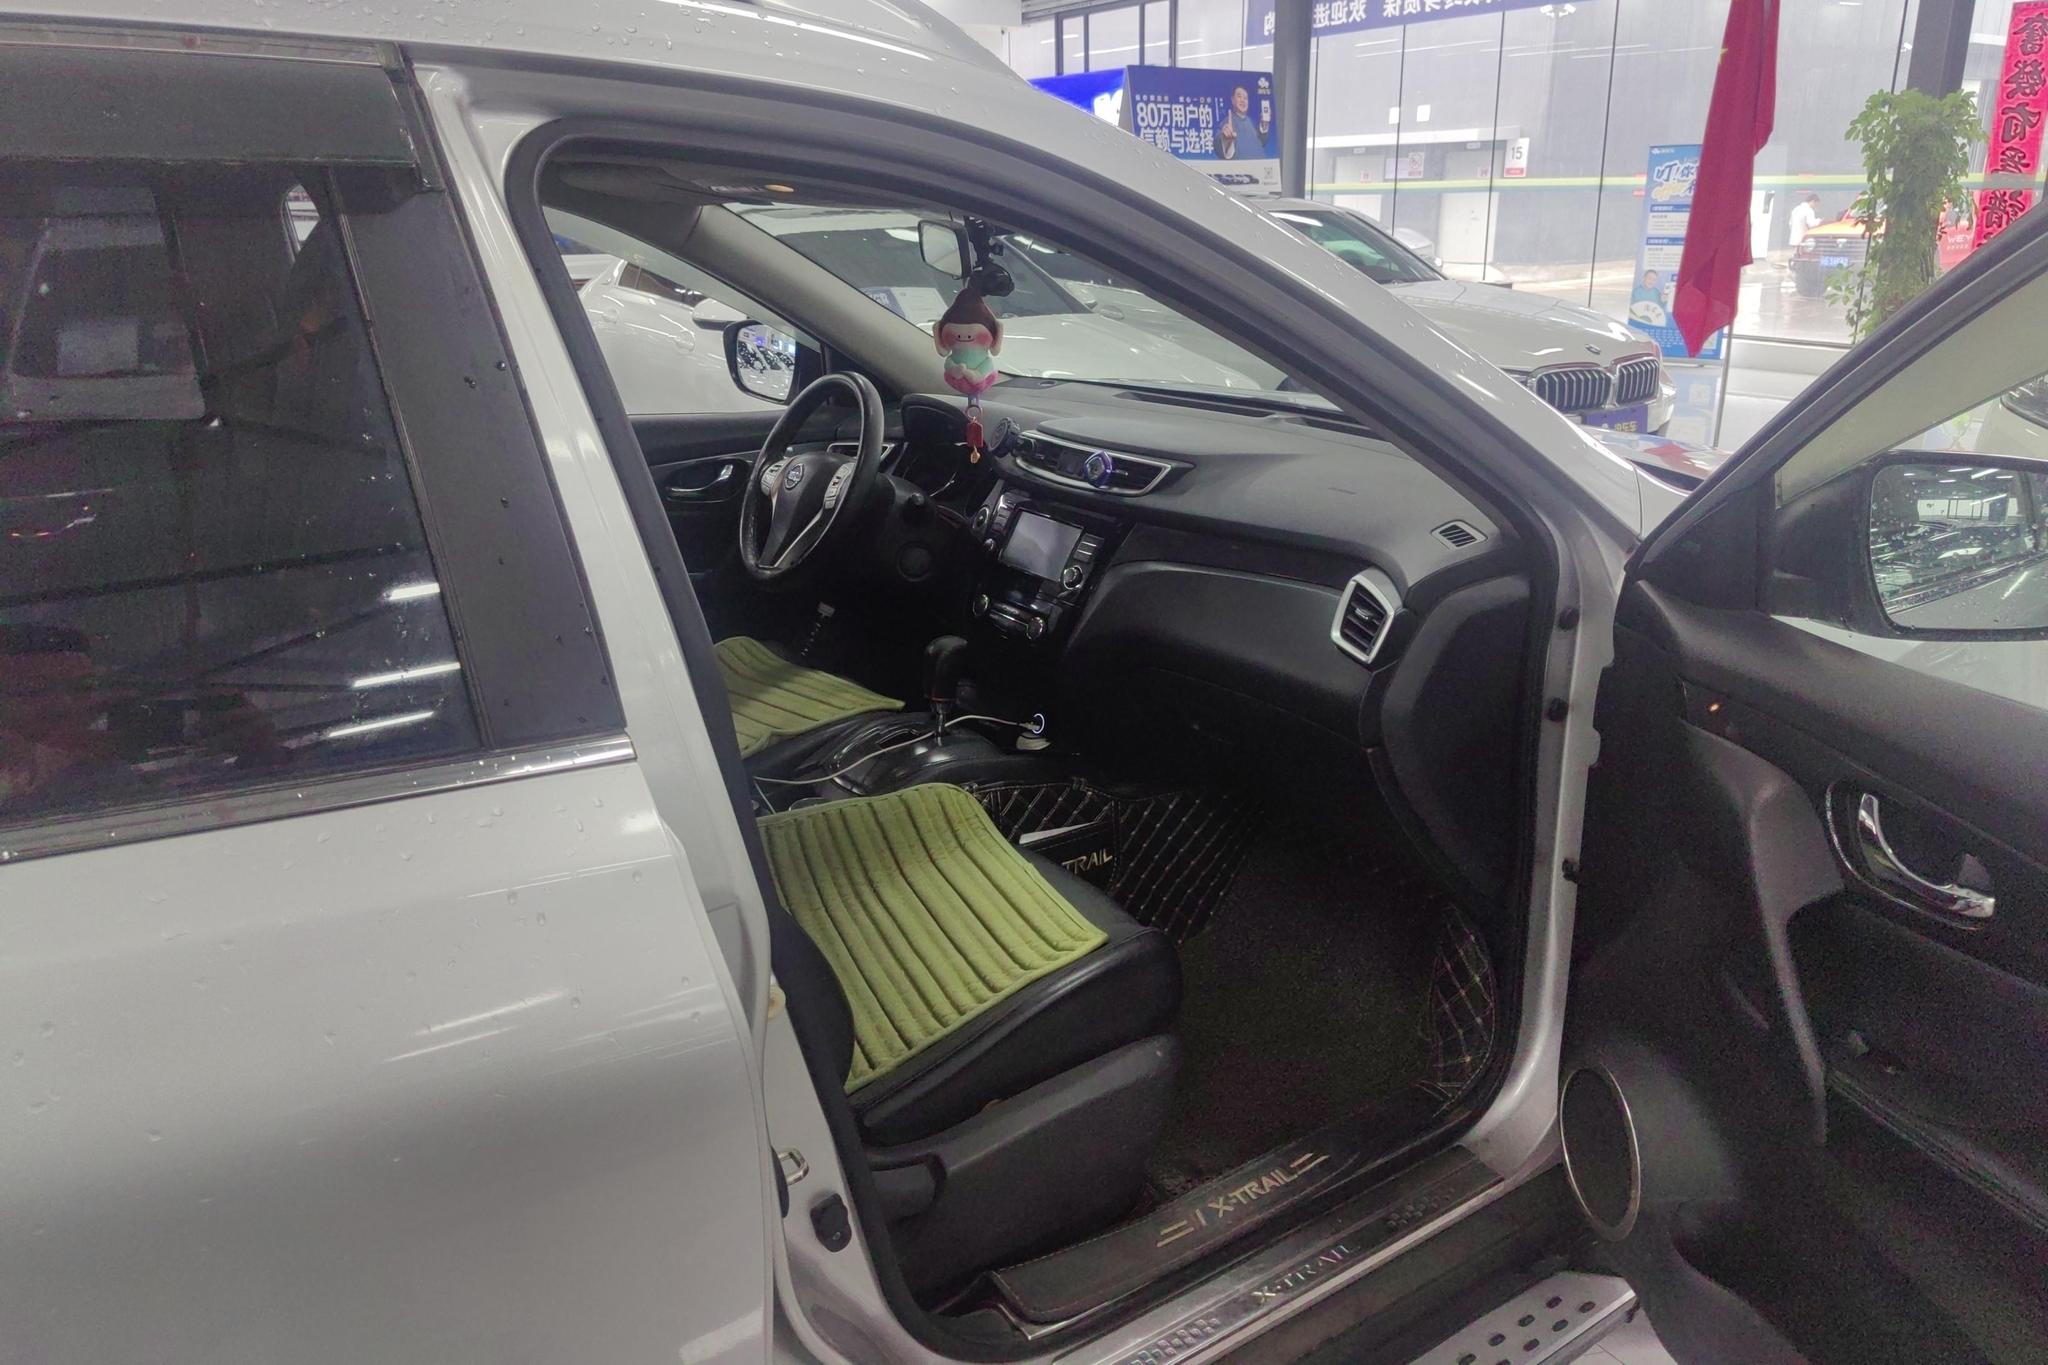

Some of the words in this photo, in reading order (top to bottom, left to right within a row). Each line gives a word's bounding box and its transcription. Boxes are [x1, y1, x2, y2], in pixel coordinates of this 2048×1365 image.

[1136, 102, 1213, 128] 80万用户的
[1139, 127, 1214, 154] 信赖与选择
[1511, 146, 1523, 160] 15
